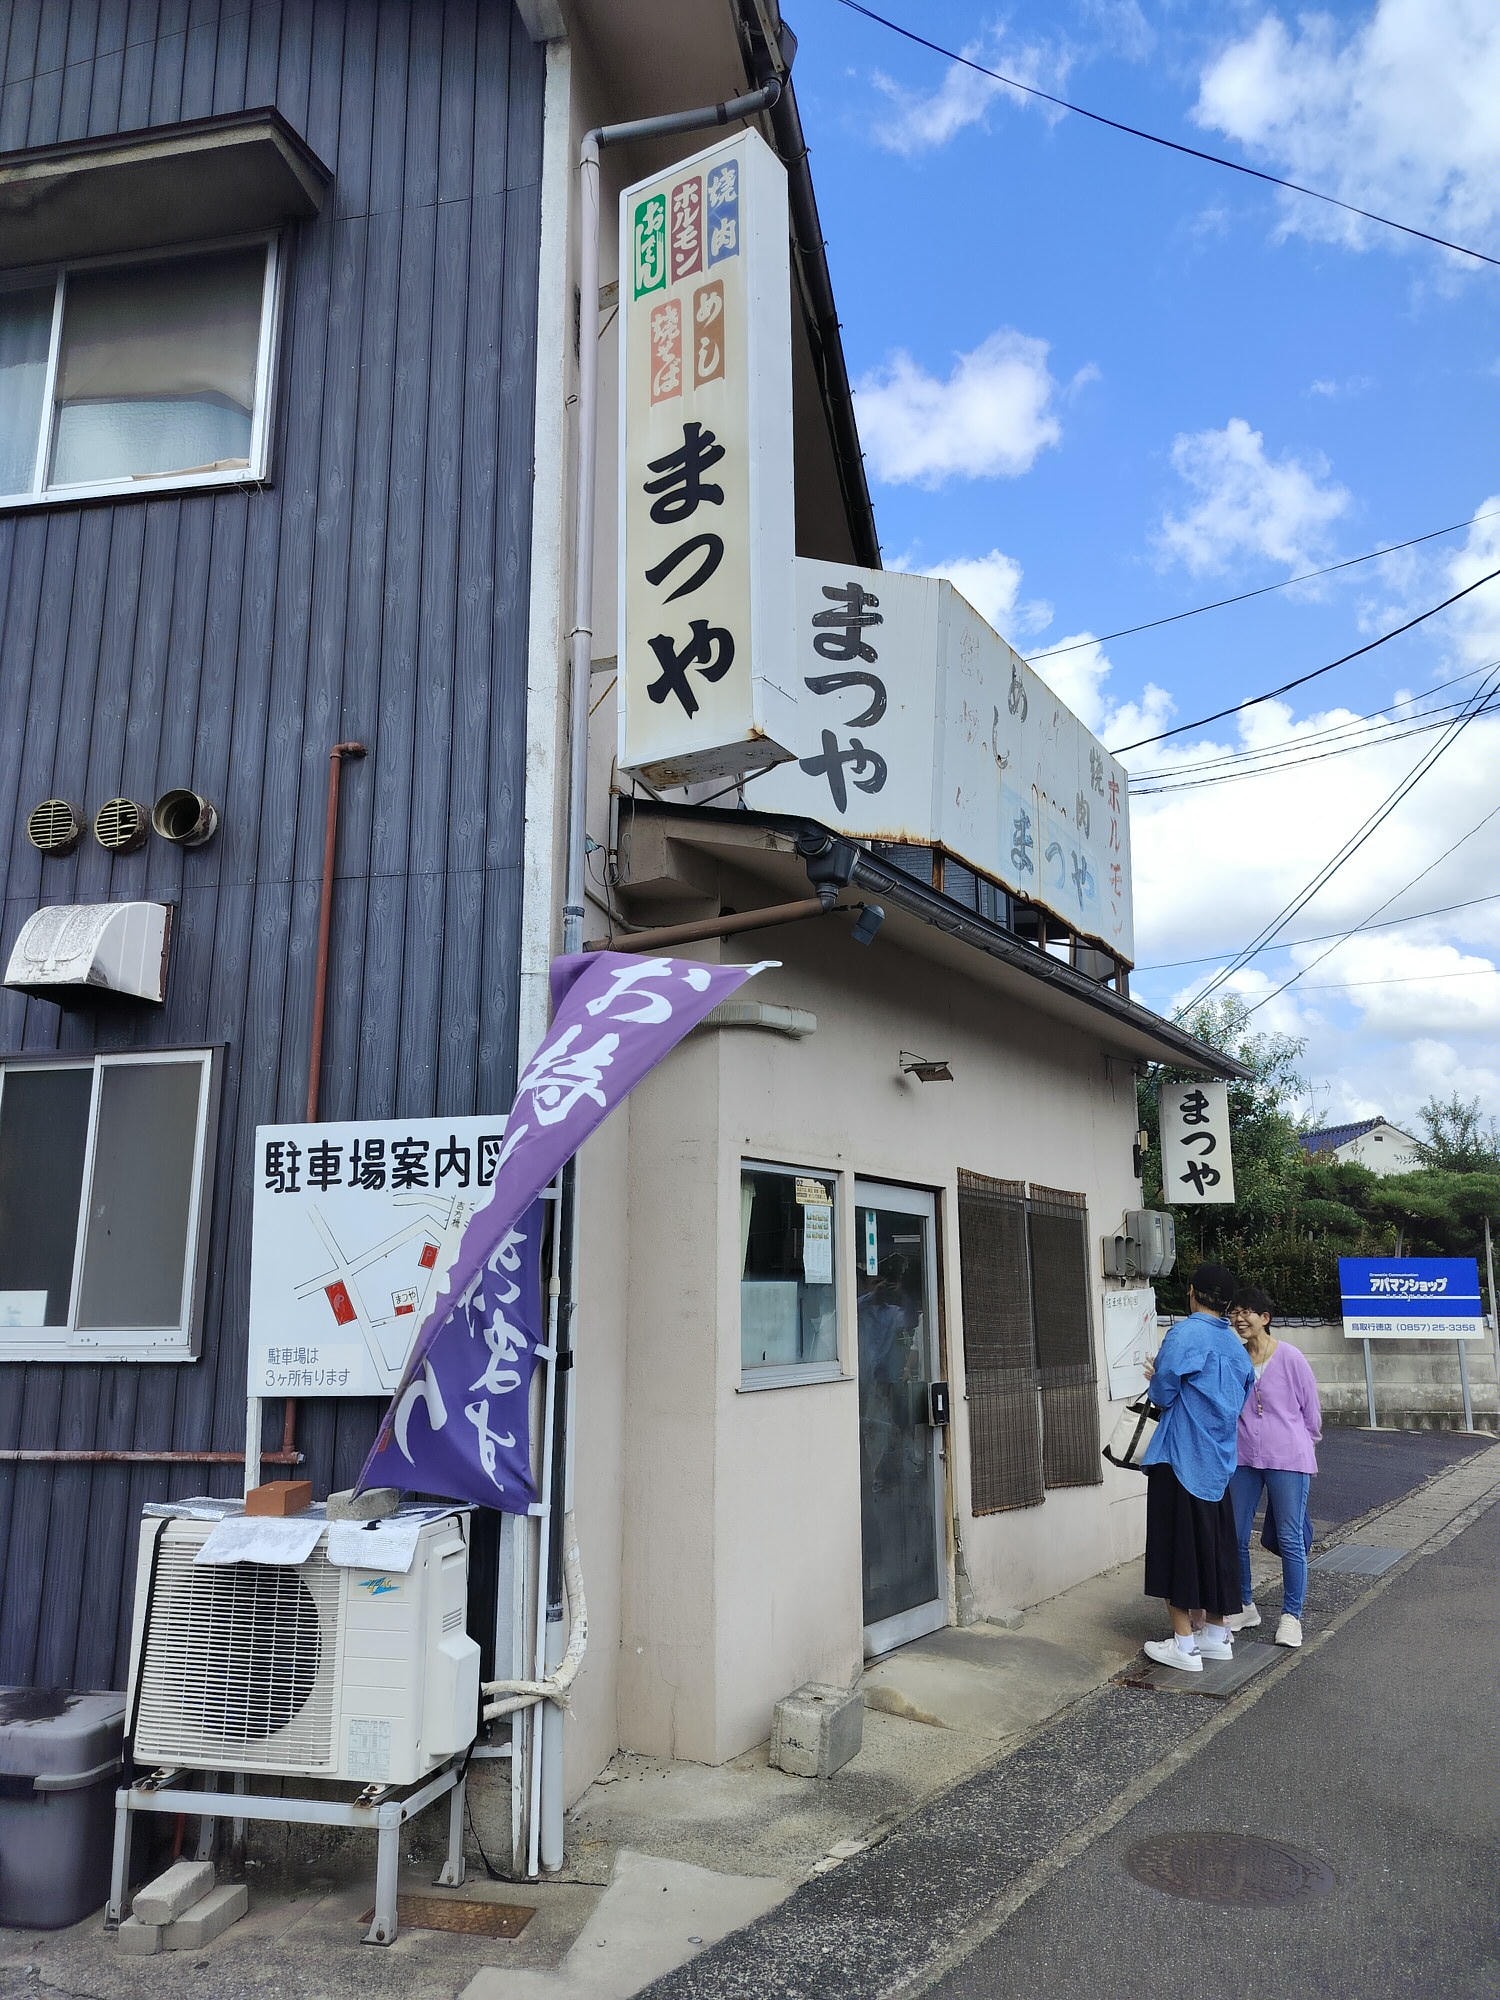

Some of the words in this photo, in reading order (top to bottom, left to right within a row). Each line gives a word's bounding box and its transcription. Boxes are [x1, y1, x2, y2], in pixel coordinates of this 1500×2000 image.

[635, 200, 664, 290] おでん
[672, 182, 699, 276] ホルモン
[707, 167, 738, 257] 焼肉
[653, 305, 681, 397] 焼そば
[696, 292, 722, 378] めし
[642, 421, 736, 720] まつや
[799, 581, 889, 814] まつや
[1009, 807, 1096, 913] まつや
[264, 1135, 505, 1194] 駐車場案内図
[1179, 1088, 1221, 1197] まつや
[395, 1290, 417, 1305] まつや
[1369, 1277, 1448, 1292] アパマンショップ
[267, 1346, 320, 1366] 駐車場は
